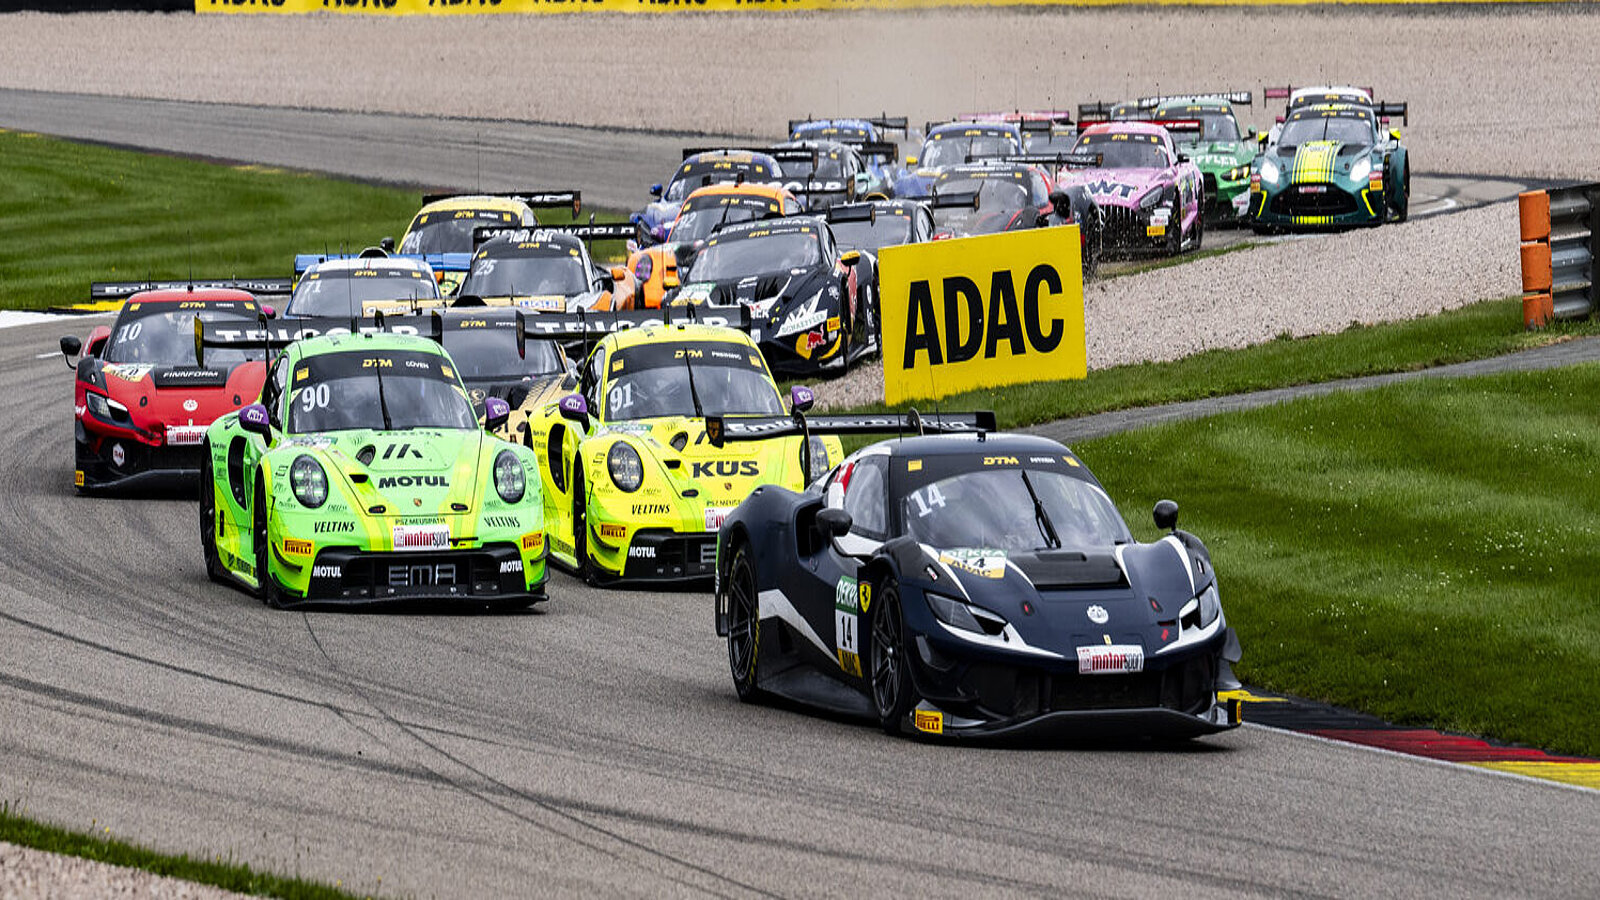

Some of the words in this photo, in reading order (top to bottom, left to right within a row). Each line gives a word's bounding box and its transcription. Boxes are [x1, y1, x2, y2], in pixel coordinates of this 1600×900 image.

[1086, 181, 1135, 198] WT
[474, 259, 498, 276] 25
[304, 279, 322, 294] 71
[179, 301, 206, 310] DTM
[903, 263, 1064, 370] ADAC
[460, 320, 487, 329] DTM
[118, 321, 143, 344] 10
[673, 349, 703, 359] DTM
[362, 358, 393, 368] DTM
[162, 370, 218, 379] FINNFORM
[302, 383, 330, 412] 90
[609, 383, 635, 413] 91
[983, 456, 1019, 466] DTM
[691, 460, 759, 479] KÜS
[378, 475, 450, 489] MOTUL
[910, 482, 946, 518] 14
[631, 504, 669, 516] VELTINS
[314, 520, 356, 533] VELTINS
[483, 516, 521, 528] VELTINS
[601, 524, 626, 538] PIRELLI
[404, 530, 450, 548] motorsport
[523, 533, 543, 550] PIRELLI
[284, 540, 313, 555] PIRELLI
[629, 545, 656, 558] MOTUL
[313, 565, 342, 578] MOTUL
[500, 560, 524, 574] MOTUL
[388, 564, 456, 586] EMA
[841, 615, 853, 649] 14
[1091, 652, 1143, 672] motorsport
[916, 713, 941, 731] PIRELLI
